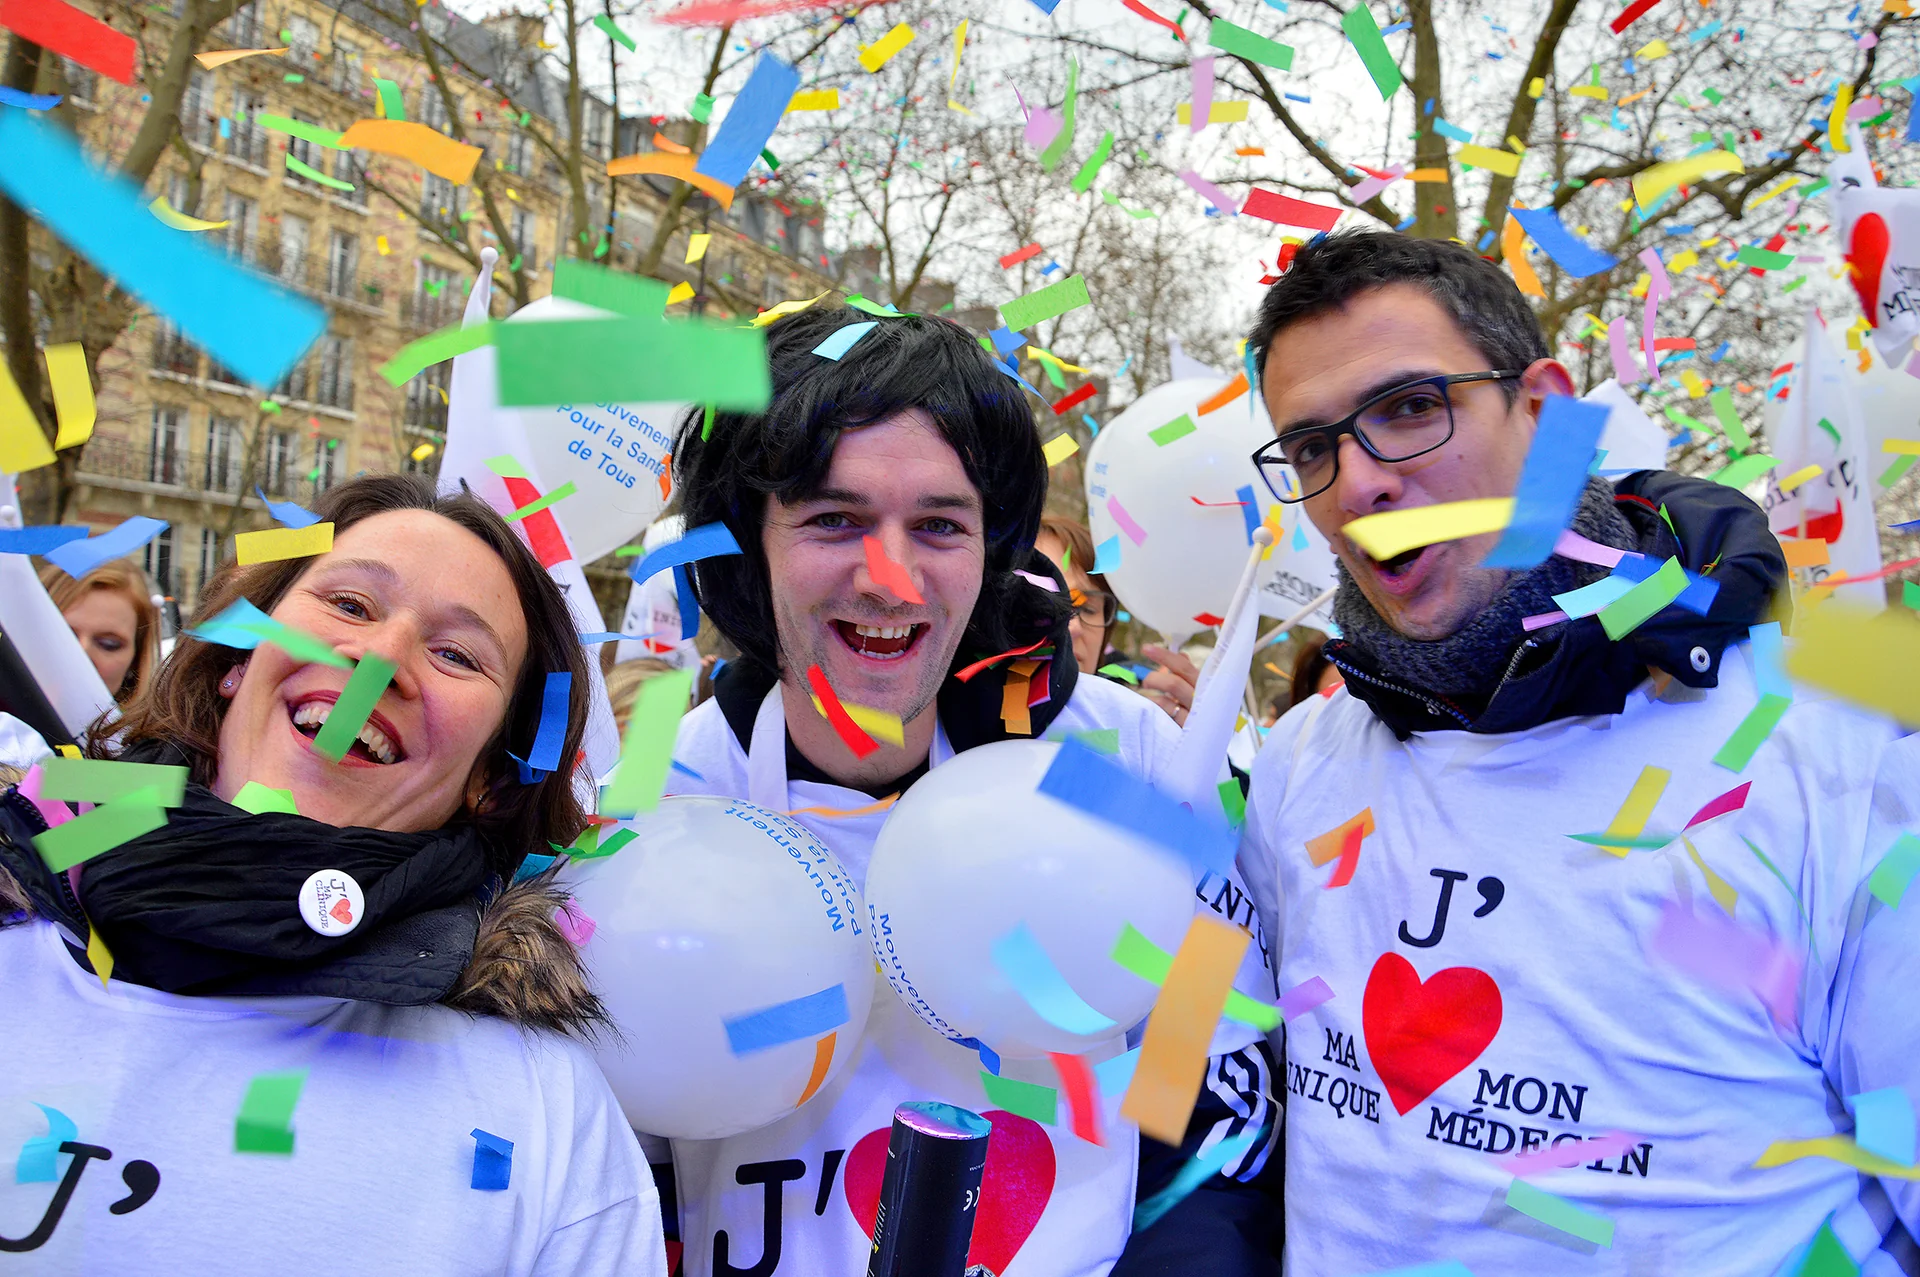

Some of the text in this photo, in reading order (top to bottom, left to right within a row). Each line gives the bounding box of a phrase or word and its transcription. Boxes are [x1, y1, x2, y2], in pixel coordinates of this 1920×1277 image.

[556, 403, 605, 435] Pour
[606, 428, 624, 449] la
[567, 439, 636, 489] de Tous
[724, 807, 845, 932] Mouvement
[1322, 1027, 1361, 1072] MA
[1473, 1068, 1588, 1123] MON
